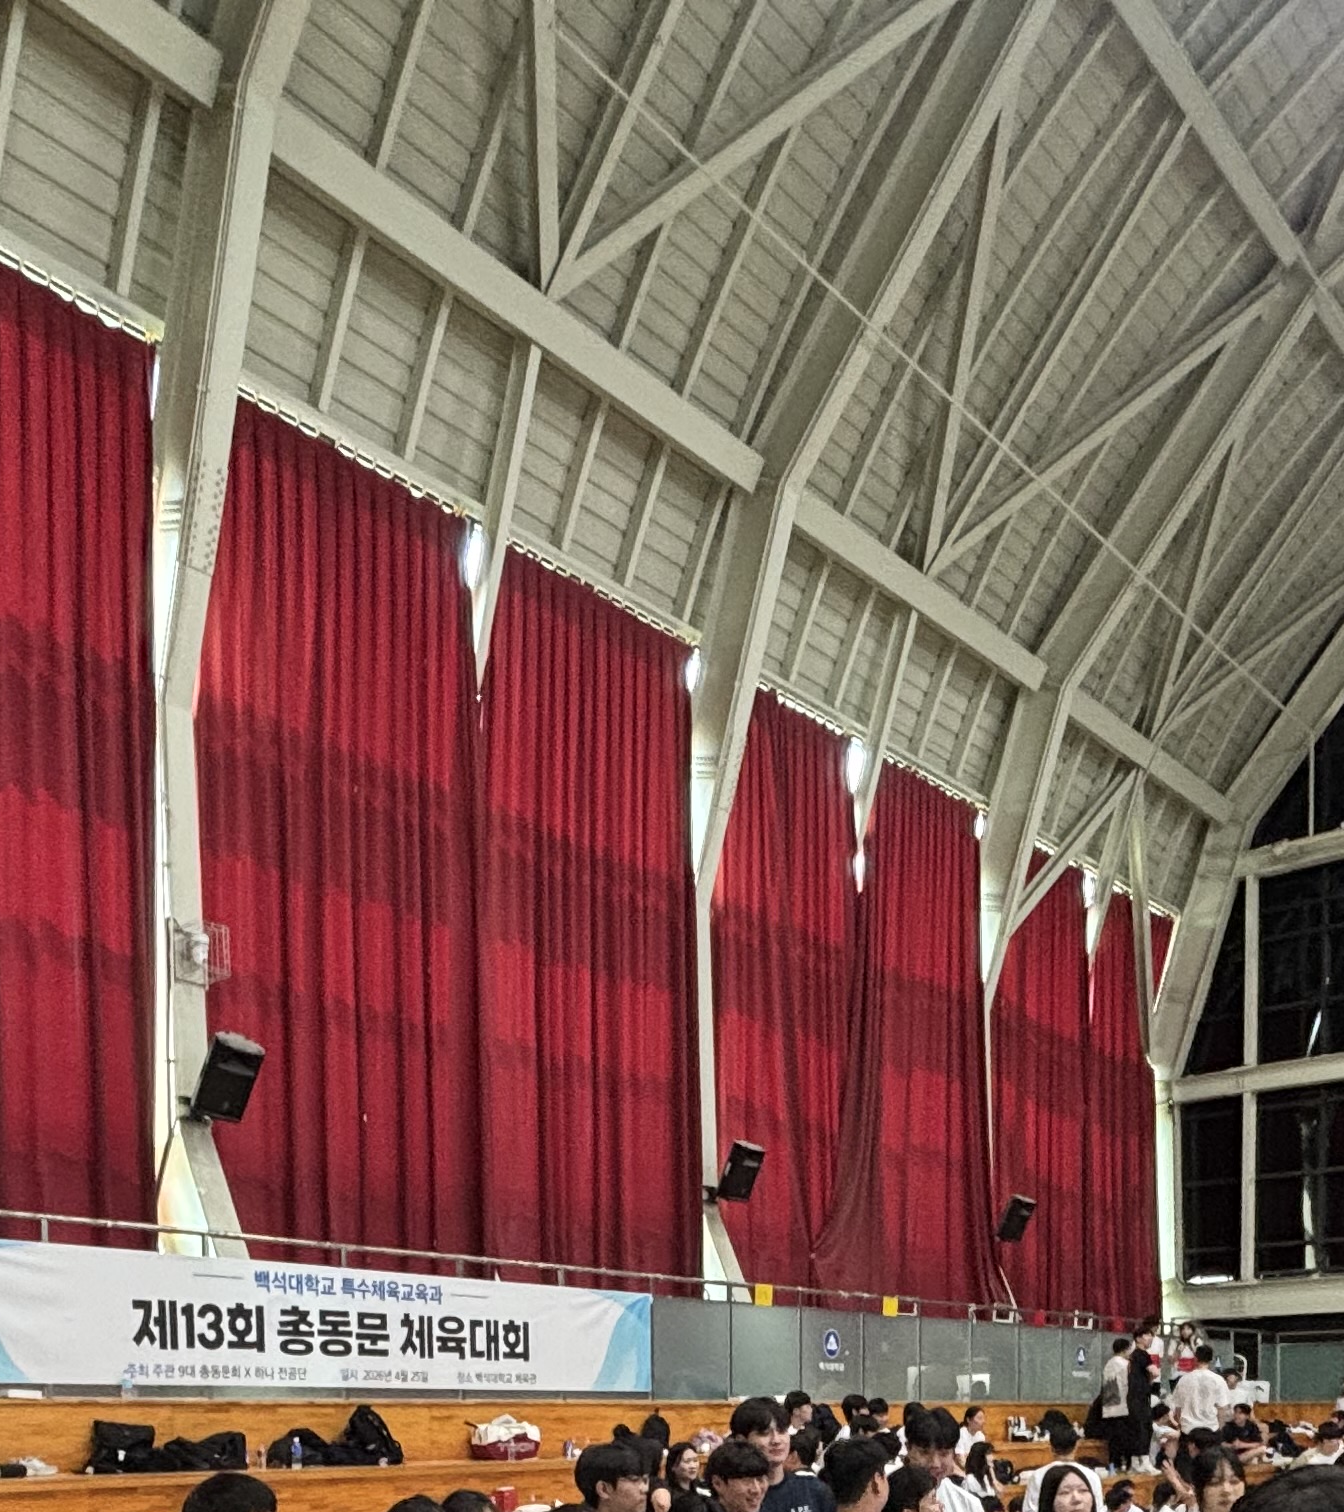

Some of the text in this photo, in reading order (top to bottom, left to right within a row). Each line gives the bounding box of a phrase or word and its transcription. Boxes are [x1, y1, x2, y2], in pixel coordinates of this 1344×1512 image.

[254, 1270, 443, 1305] 백석대학교 특수체육교육과
[131, 1299, 531, 1362] 제13회 총동문 체육대회
[152, 1364, 175, 1379] 주관
[199, 1365, 241, 1379] 총동문회
